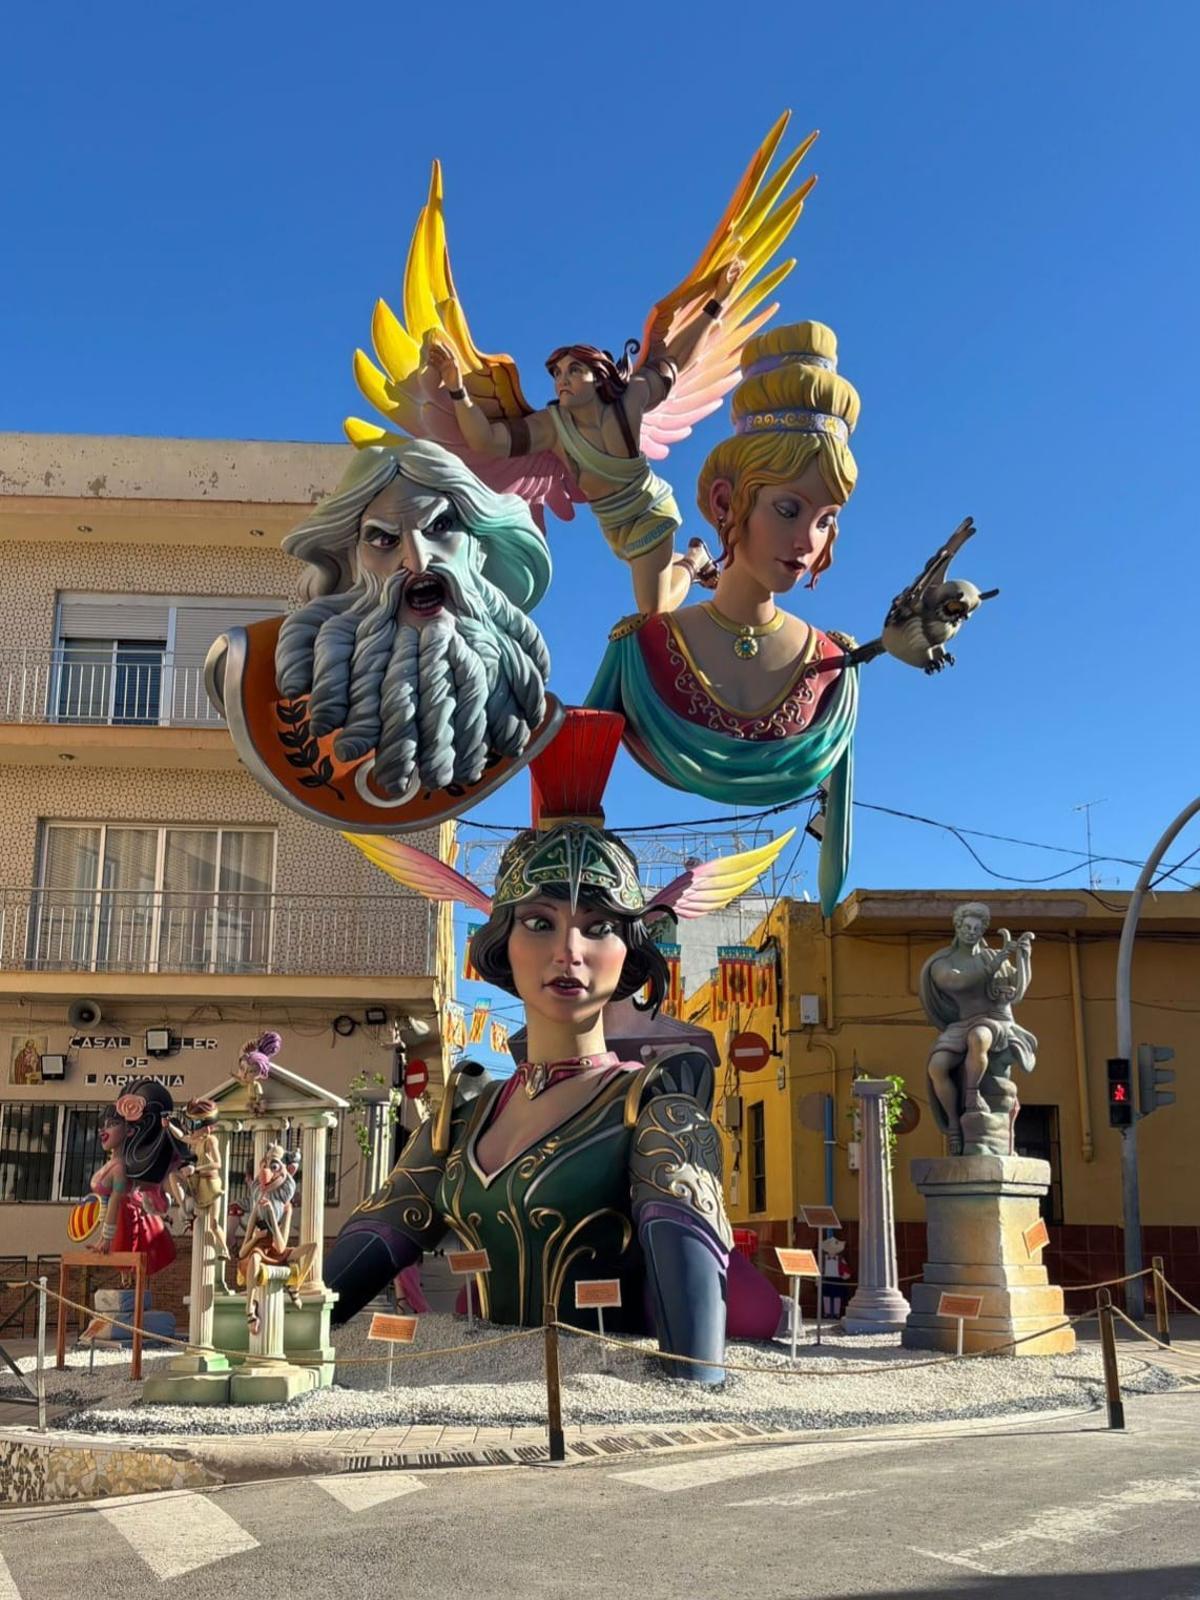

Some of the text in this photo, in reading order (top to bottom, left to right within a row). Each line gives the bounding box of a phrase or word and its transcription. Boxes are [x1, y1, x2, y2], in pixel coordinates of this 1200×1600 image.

[69, 1037, 218, 1049] CASAL LER
[123, 1057, 148, 1068] DE
[84, 1075, 97, 1087] L
